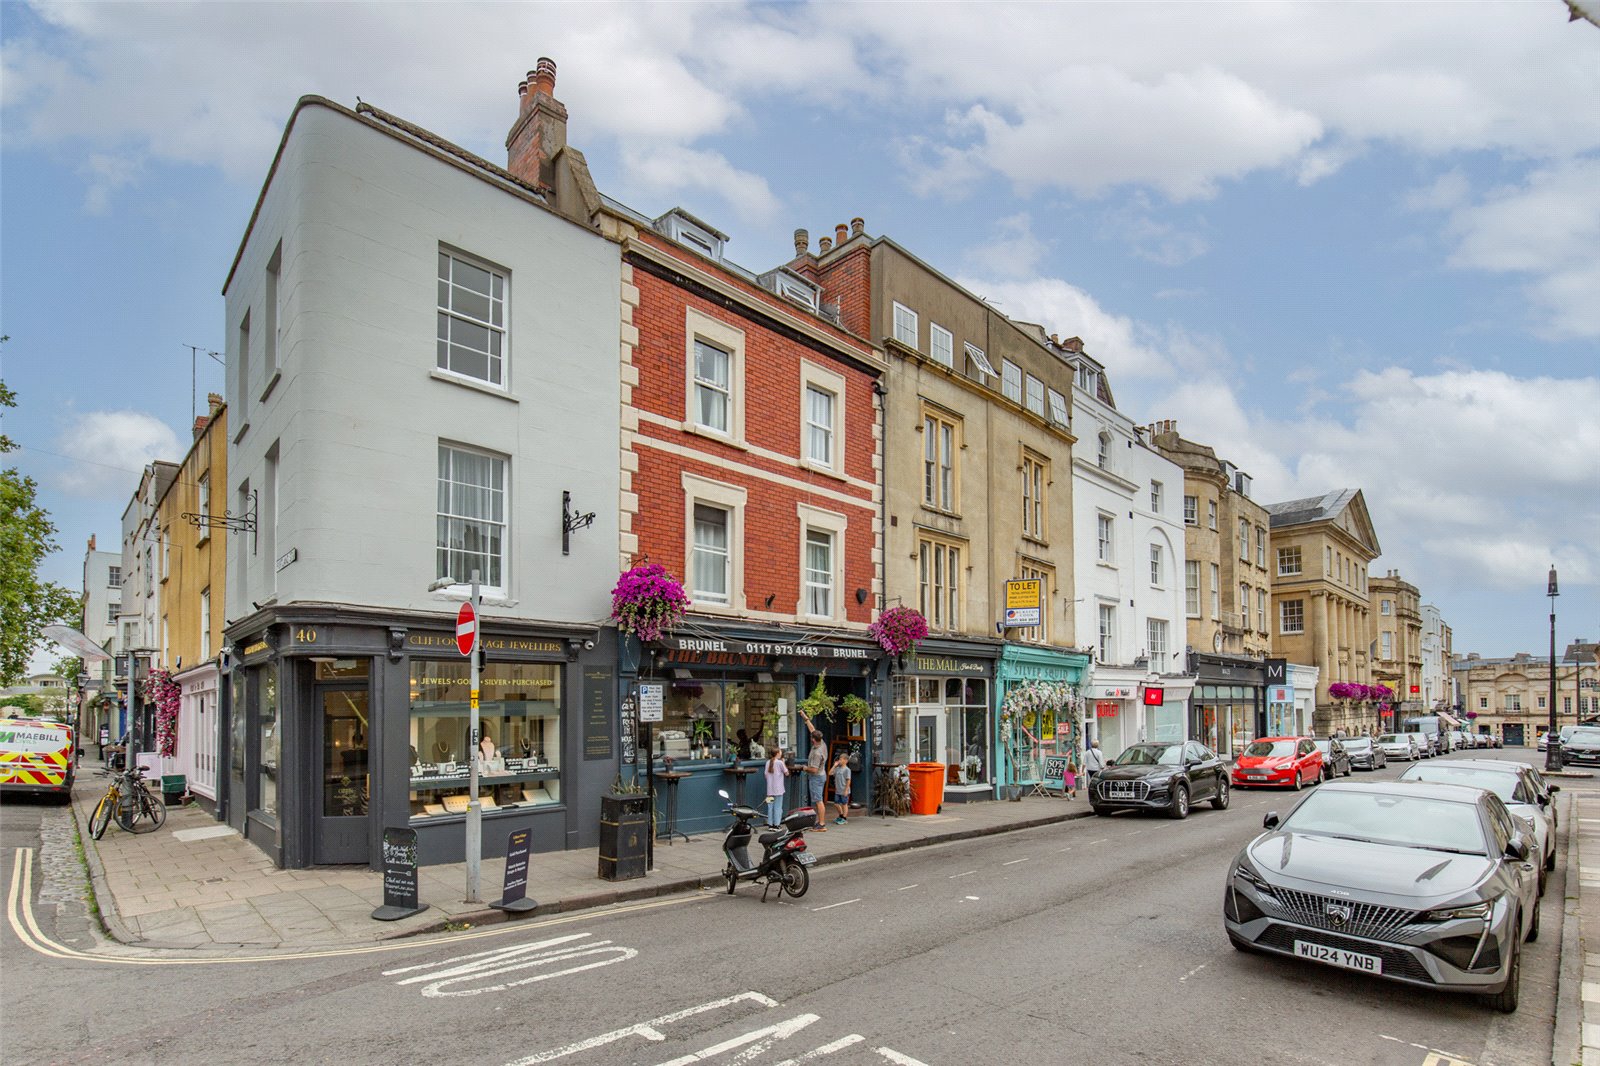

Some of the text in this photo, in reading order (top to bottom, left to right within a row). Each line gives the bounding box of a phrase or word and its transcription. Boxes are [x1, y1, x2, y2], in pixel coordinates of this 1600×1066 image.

[296, 628, 316, 643] 40
[508, 641, 561, 652] JEWELLERS
[679, 640, 868, 658] BRUNEL 0117 973 4443 BRUNEL
[668, 649, 768, 666] THE BRUNEL
[917, 658, 960, 671] THE MALL
[1015, 665, 1068, 678] SILVER SQUID
[1268, 666, 1282, 677] M
[1096, 704, 1119, 717] OUTLET
[16, 732, 60, 742] MAEBILL
[1048, 760, 1064, 768] 50%
[1301, 943, 1374, 970] WU24 YNB
